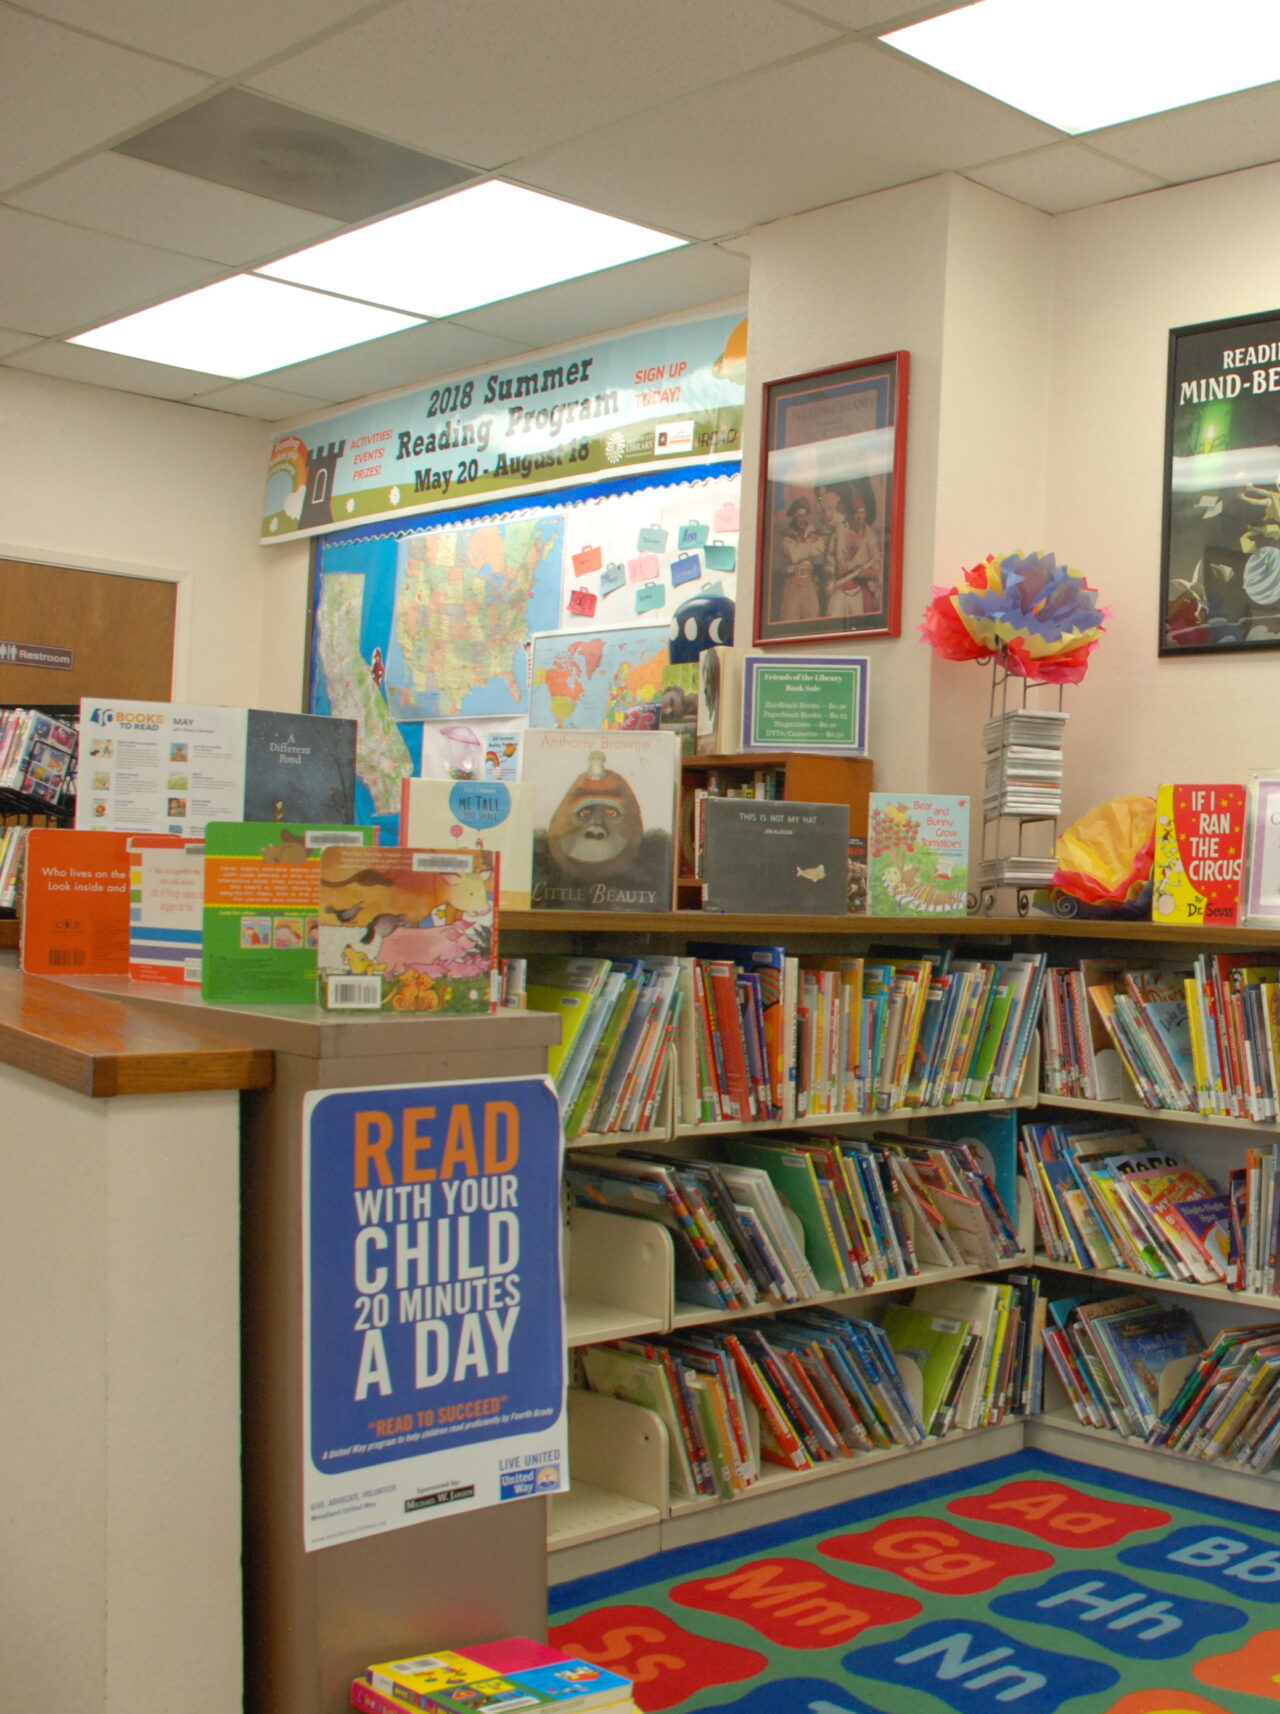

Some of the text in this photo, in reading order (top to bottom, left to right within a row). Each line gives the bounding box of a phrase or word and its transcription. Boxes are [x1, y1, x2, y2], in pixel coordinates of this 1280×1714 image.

[634, 361, 688, 385] SIGN UP
[426, 357, 594, 418] 2018 Summer
[635, 386, 682, 408] TODAY!
[395, 389, 620, 462] Reading Program
[351, 428, 394, 449] ACTIVITIES!
[353, 447, 386, 465] EVENTS!
[352, 464, 382, 482] PRIZES!
[414, 436, 590, 496] May 20 August 18
[19, 649, 70, 664] Restroom
[115, 711, 165, 725] BOOKS
[119, 722, 160, 731] TO READ
[173, 717, 194, 727] MAY
[287, 734, 296, 743] A
[541, 735, 650, 751] Anthony Browne
[269, 742, 312, 755] Different
[279, 753, 302, 765] Pond
[458, 797, 472, 811] ME
[913, 799, 933, 811] Bear
[1191, 791, 1215, 811] IF I
[739, 813, 818, 825] THIS IS NOT MY HAT
[933, 806, 950, 816] and
[926, 816, 955, 828] Bunny
[1199, 813, 1231, 835] RAN
[935, 827, 959, 839] Grow
[920, 837, 963, 849] Tomatoes
[1189, 837, 1219, 858] THE
[42, 867, 126, 879] Who lives on the
[1189, 858, 1243, 882] CIRCUS
[48, 882, 126, 893] Look inside and
[1187, 902, 1234, 918] Dr. Seuss
[353, 1100, 520, 1189] READ
[354, 1174, 519, 1226] WITH YOUR
[354, 1210, 520, 1295] CHILD
[354, 1273, 521, 1331] 20 MINUTES
[354, 1305, 521, 1401] A DAY
[418, 1410, 435, 1429] TO
[499, 1448, 561, 1472] LIVE UNITED
[501, 1471, 535, 1486] United
[513, 1482, 535, 1496] Way
[987, 1493, 1116, 1534] Aa
[872, 1530, 996, 1582] Gg
[704, 1564, 871, 1636] Mm
[1036, 1580, 1184, 1641] Hh
[560, 1625, 686, 1683] Ss
[893, 1632, 1048, 1701] Nn
